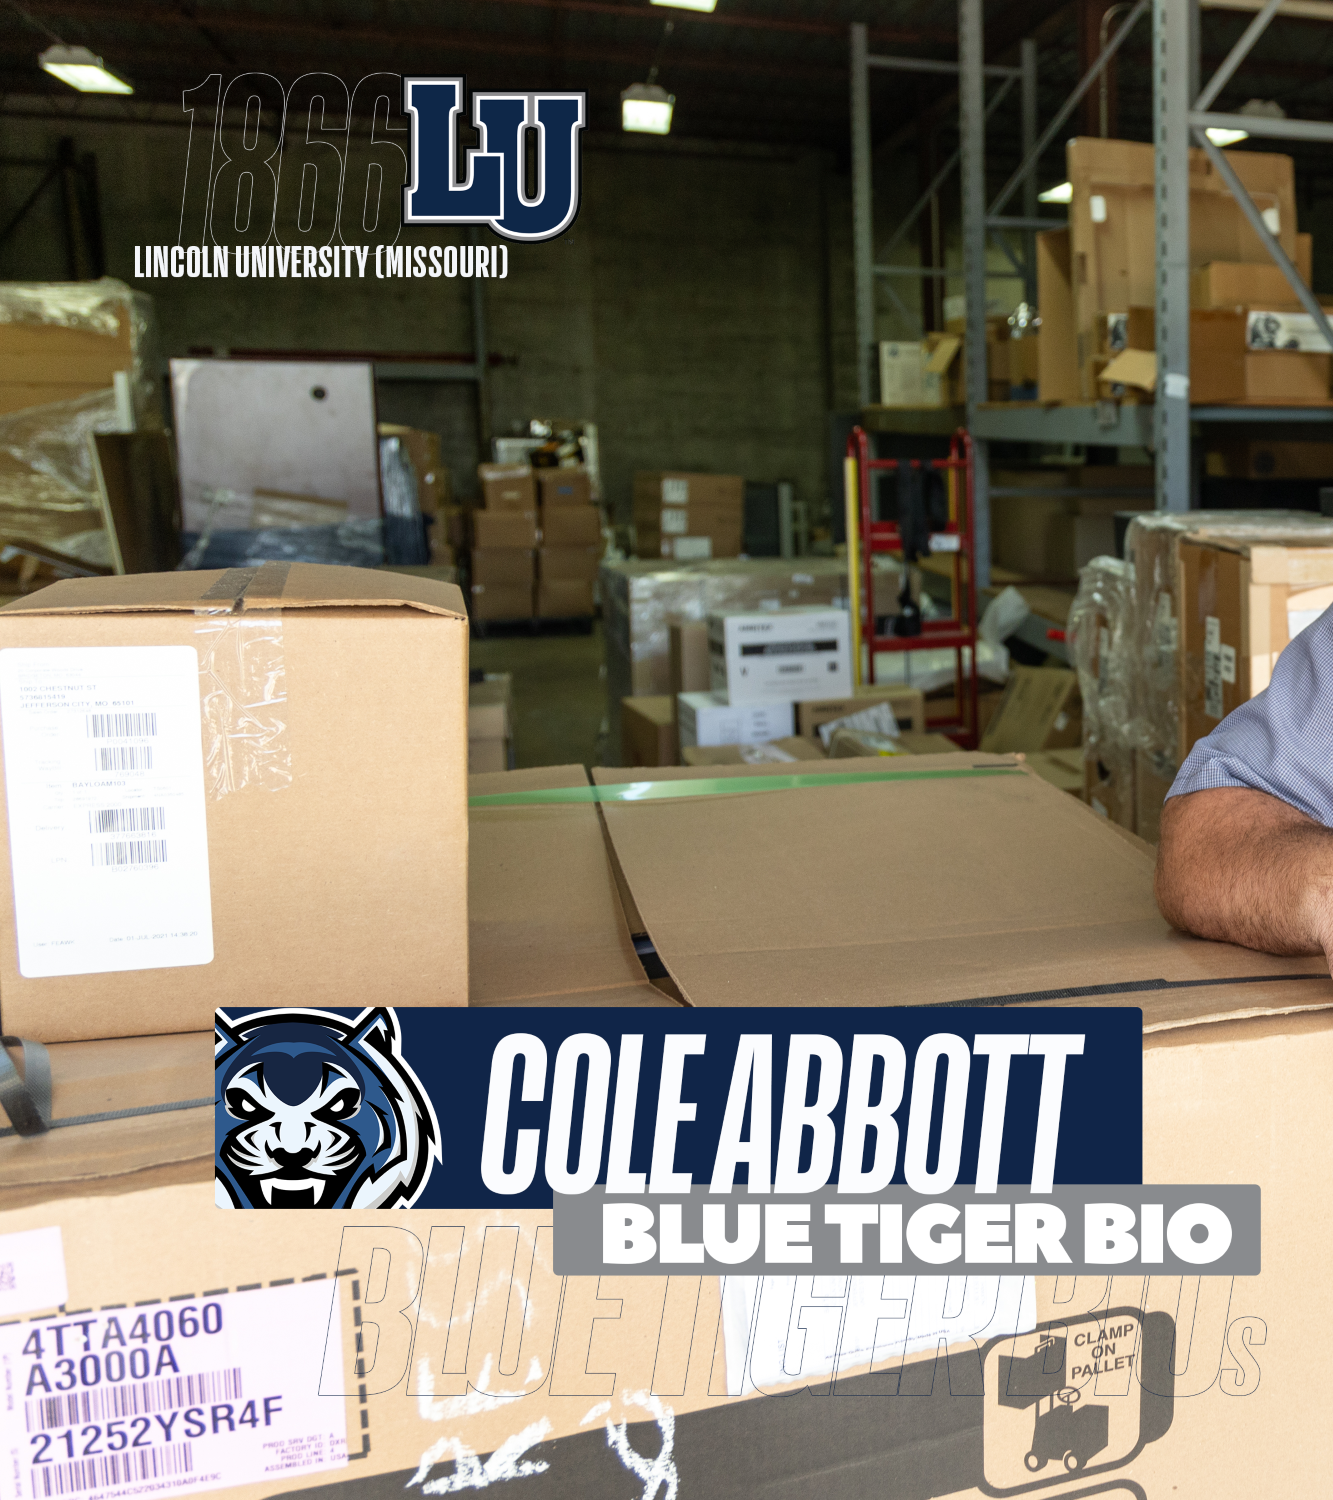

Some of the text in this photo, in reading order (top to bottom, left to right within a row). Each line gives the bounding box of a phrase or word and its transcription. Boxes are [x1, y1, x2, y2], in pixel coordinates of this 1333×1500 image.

[106, 737, 149, 745] P0041096
[115, 770, 146, 778] 769048
[72, 780, 126, 789] BAYLOAM103
[35, 824, 65, 832] Delivery
[110, 831, 157, 840] 377663816
[111, 863, 160, 873] B02760396
[22, 1302, 224, 1360] 4TTA4060
[1073, 1323, 1135, 1347] CLAMP
[1090, 1342, 1117, 1360] ON
[25, 1344, 181, 1397] A3000A
[1071, 1353, 1136, 1380] PALLET
[29, 1395, 283, 1464] 21252YSR4F
[262, 1440, 285, 1449] PROD
[287, 1437, 304, 1446] SRV
[275, 1443, 312, 1455] FACTORY
[264, 1458, 312, 1472] ASSEMBLED
[330, 1452, 346, 1462] USA
[281, 1452, 303, 1462] PROD
